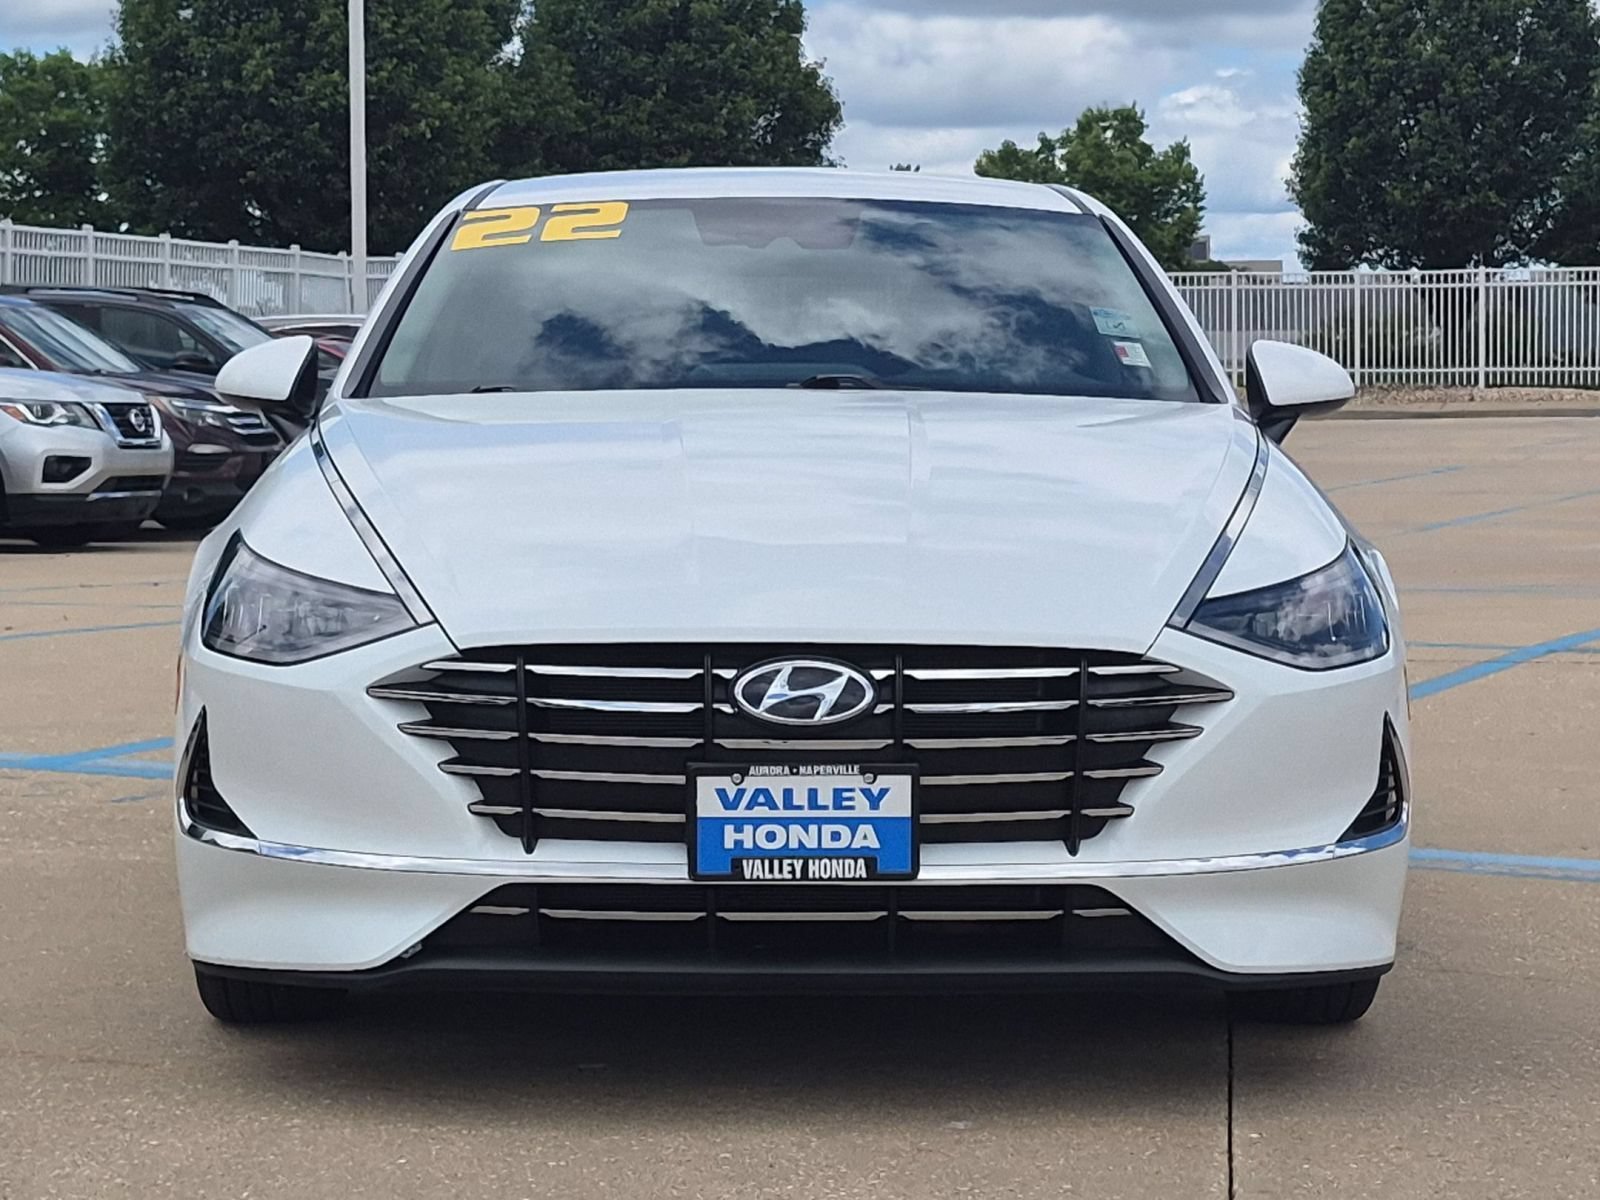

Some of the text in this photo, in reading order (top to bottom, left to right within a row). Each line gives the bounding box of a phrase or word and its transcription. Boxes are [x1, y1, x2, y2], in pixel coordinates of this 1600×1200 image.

[450, 201, 630, 251] 22
[748, 764, 861, 776] AURORA NAPERVILLE
[714, 787, 892, 811] VALLEY
[723, 823, 881, 850] HONDA
[742, 858, 868, 880] VALLEY HONDA
